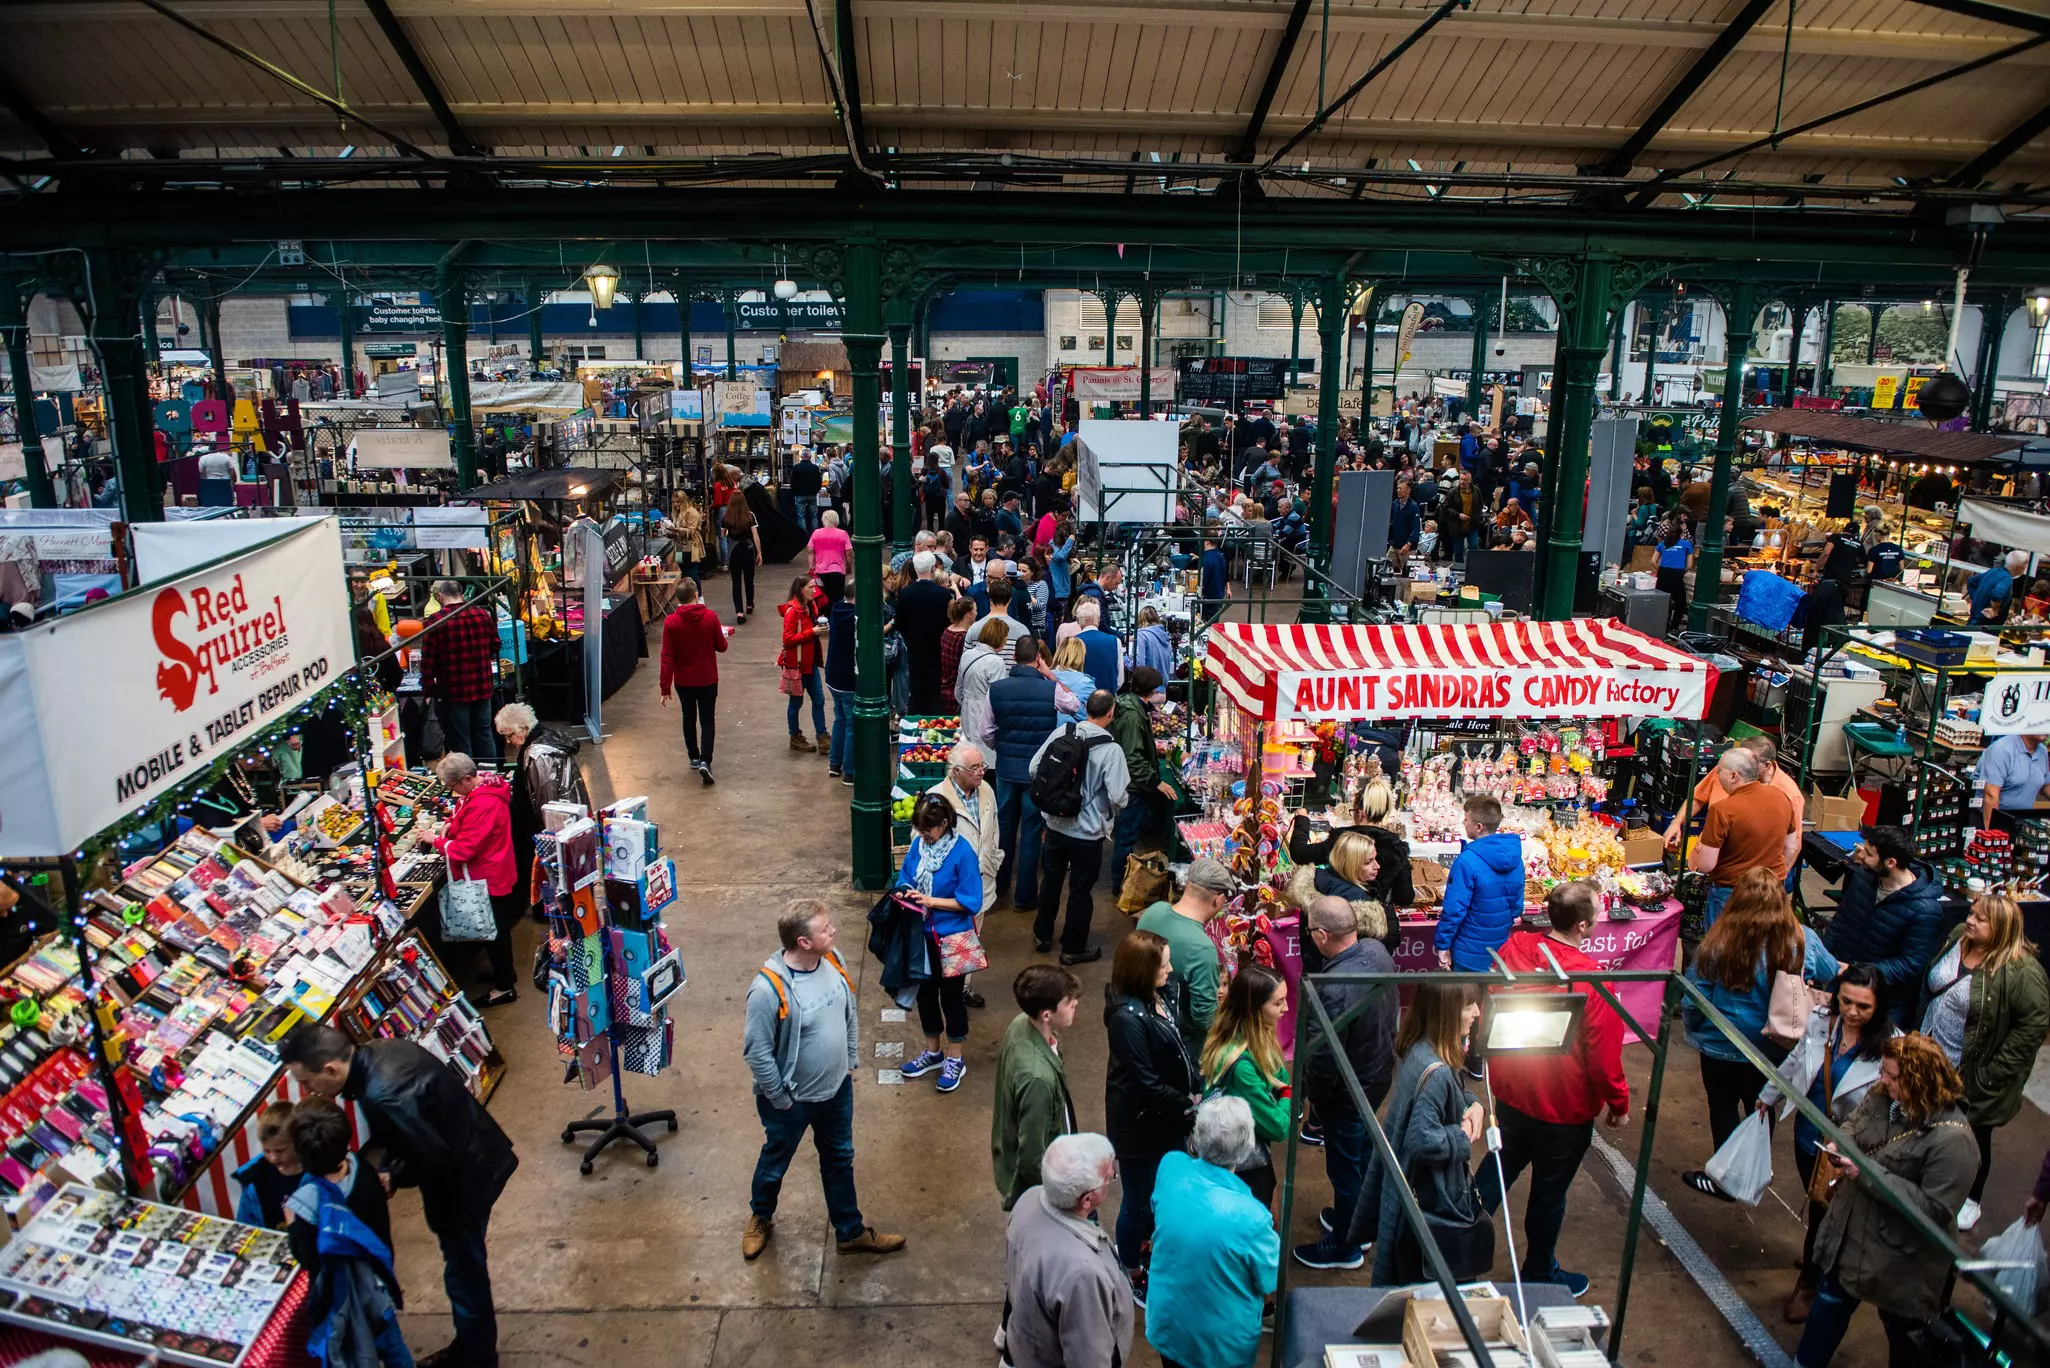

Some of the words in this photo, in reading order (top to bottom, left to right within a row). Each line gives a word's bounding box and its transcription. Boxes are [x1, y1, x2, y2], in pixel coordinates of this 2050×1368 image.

[373, 307, 410, 315] Customer
[412, 307, 436, 315] toilets
[740, 304, 803, 316] Custoer
[369, 316, 388, 325] baby
[389, 316, 424, 325] changing
[425, 315, 442, 323] facil
[1082, 375, 1111, 384] Paninis
[1112, 376, 1121, 384] @
[1123, 375, 1134, 384] St.
[1137, 376, 1167, 385] Grges
[1452, 372, 1495, 384] CREES
[1707, 375, 1726, 386] FALAFE
[726, 383, 739, 392] Tea
[740, 384, 747, 392] &
[725, 392, 751, 401] Coffee
[1306, 397, 1362, 409] belafe
[1015, 411, 1021, 421] 6
[190, 573, 248, 632] Red
[231, 634, 289, 675] ACCESSORIES
[1294, 675, 1380, 712] AUNT
[1386, 671, 1512, 710] SANDRA'S
[1523, 674, 1603, 709] CANDY
[1606, 677, 1680, 712] Factory
[115, 742, 184, 804] MOBILE
[189, 732, 204, 758] &
[205, 699, 255, 747] TABLET
[257, 673, 302, 715] REPAIR
[301, 657, 329, 687] POD
[1446, 719, 1464, 730] ale
[1467, 720, 1491, 731] Here
[1579, 932, 1617, 953] ast
[1623, 930, 1653, 951] for
